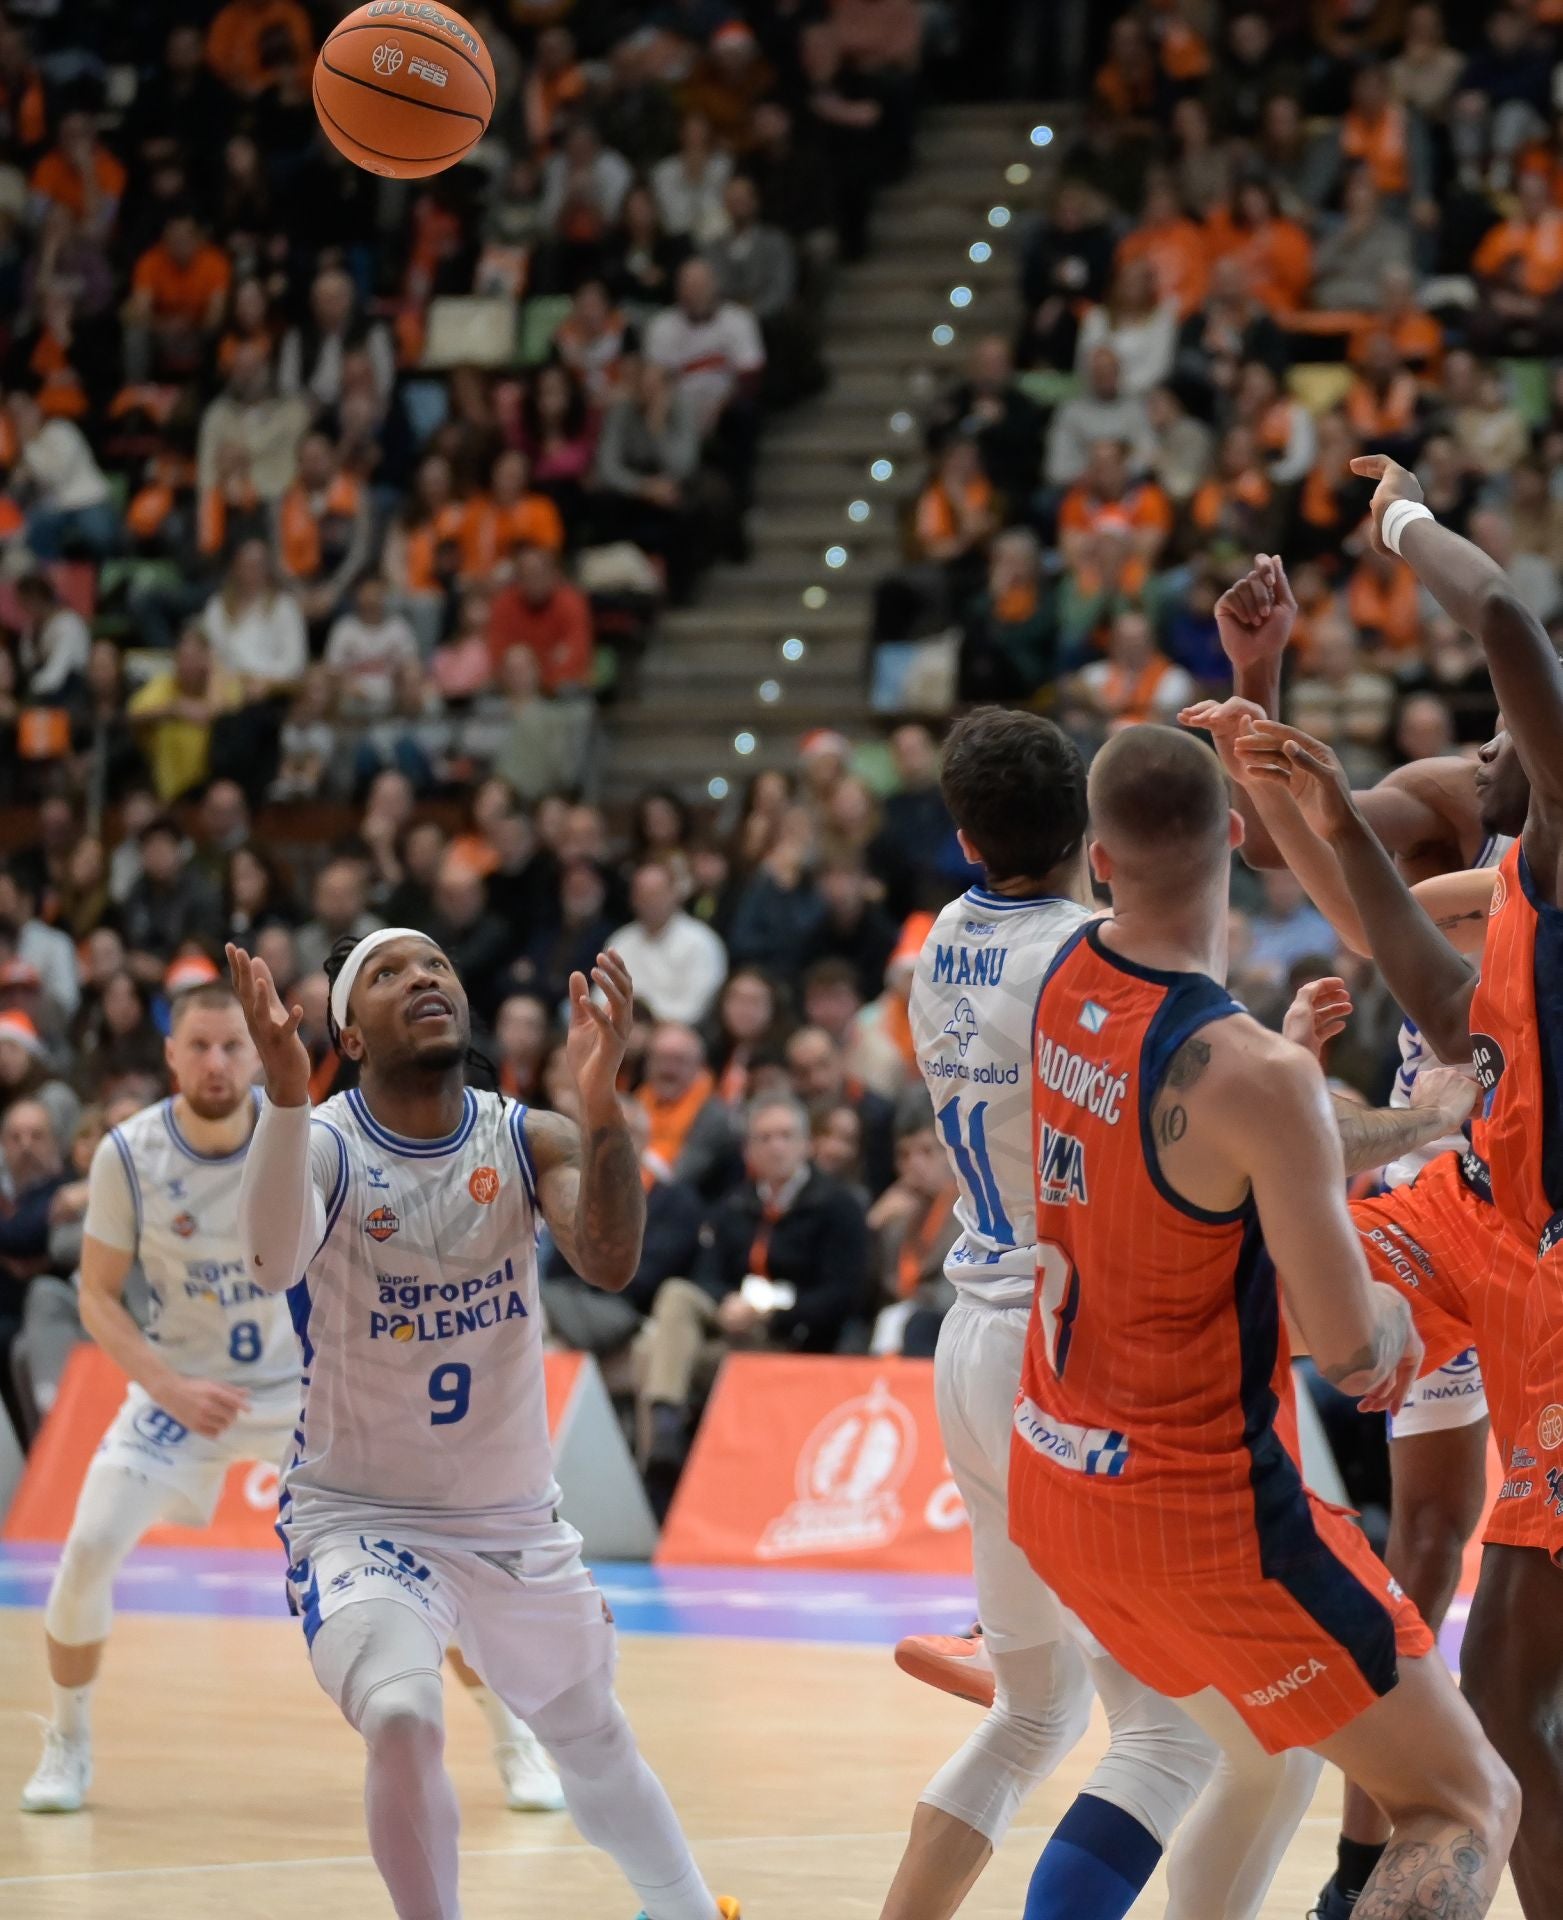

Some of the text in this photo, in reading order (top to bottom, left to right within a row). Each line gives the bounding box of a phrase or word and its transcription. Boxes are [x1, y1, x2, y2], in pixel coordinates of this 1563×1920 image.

[407, 62, 448, 88] FEB
[932, 944, 1008, 986] MANU
[973, 1062, 1018, 1084] salud
[937, 1095, 1017, 1246] 11
[1038, 1117, 1088, 1204] YMA
[378, 1257, 515, 1310] agropal
[229, 1320, 262, 1364] 8
[428, 1361, 472, 1427] 9
[1422, 1382, 1485, 1400] INMA
[1500, 1481, 1533, 1498] alicia
